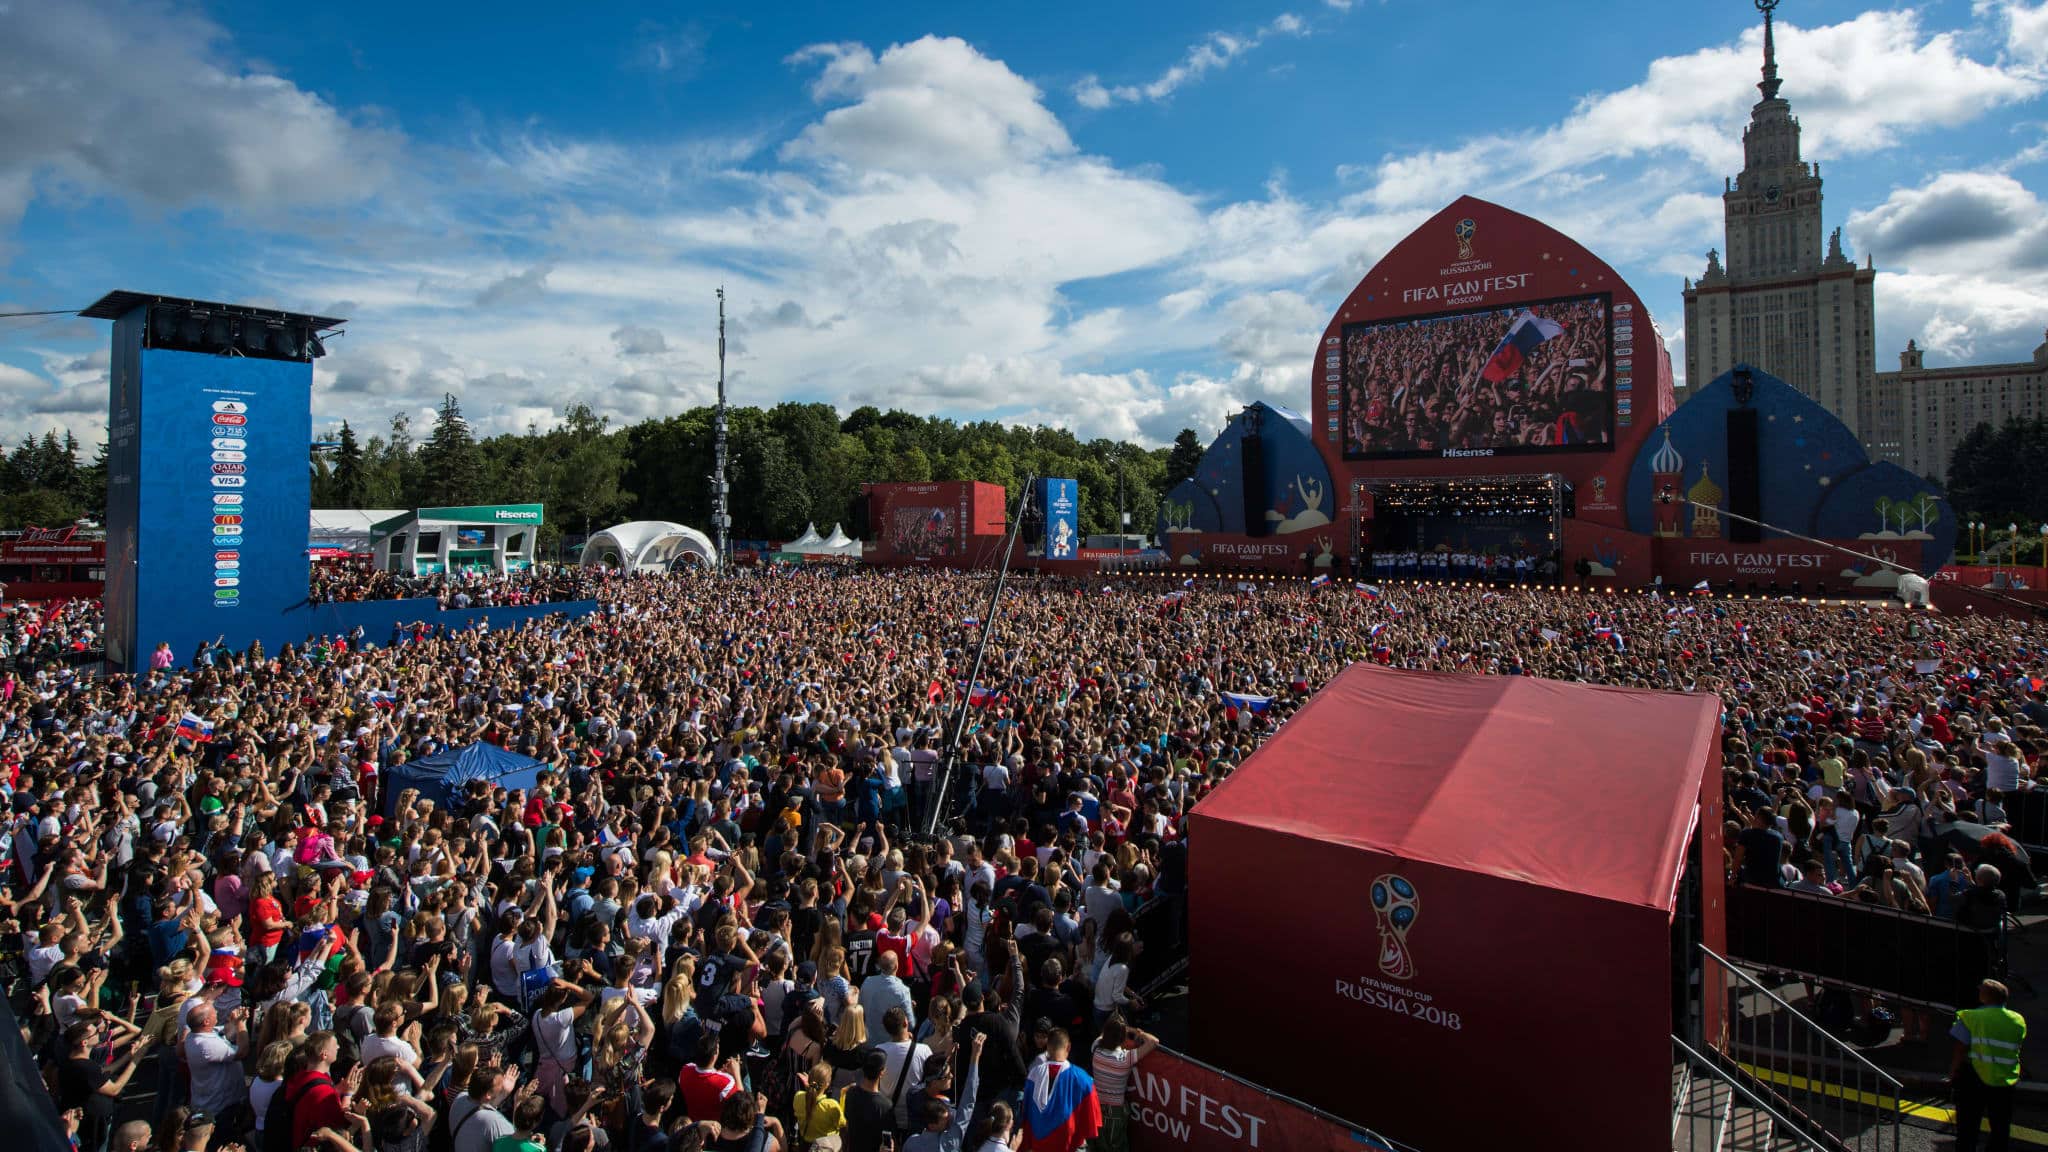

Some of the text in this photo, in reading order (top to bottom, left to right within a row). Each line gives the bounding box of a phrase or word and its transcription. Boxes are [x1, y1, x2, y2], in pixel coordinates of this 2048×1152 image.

[1440, 265, 1471, 276] RUSSIA
[1472, 262, 1492, 272] 2018
[1403, 273, 1530, 303] FIFA FAN FEST
[1446, 294, 1484, 306] MOSCOW
[1442, 448, 1494, 458] Hisense
[218, 477, 240, 485] VISA
[495, 510, 538, 519] Hisense
[29, 529, 61, 541] Bud
[1212, 543, 1288, 555] FIFA FAN FEST
[1689, 552, 1825, 568] FIFA FAN FEST
[1737, 567, 1776, 575] MOSCOW
[1934, 571, 1959, 581] EST
[850, 950, 872, 975] 17
[701, 962, 717, 986] 3
[1360, 976, 1433, 1002] FIFA WORLD CUP
[1335, 979, 1462, 1031] RUSSIA 2018
[1127, 1066, 1267, 1149] AN FEST
[1130, 1102, 1191, 1143] SCOW
